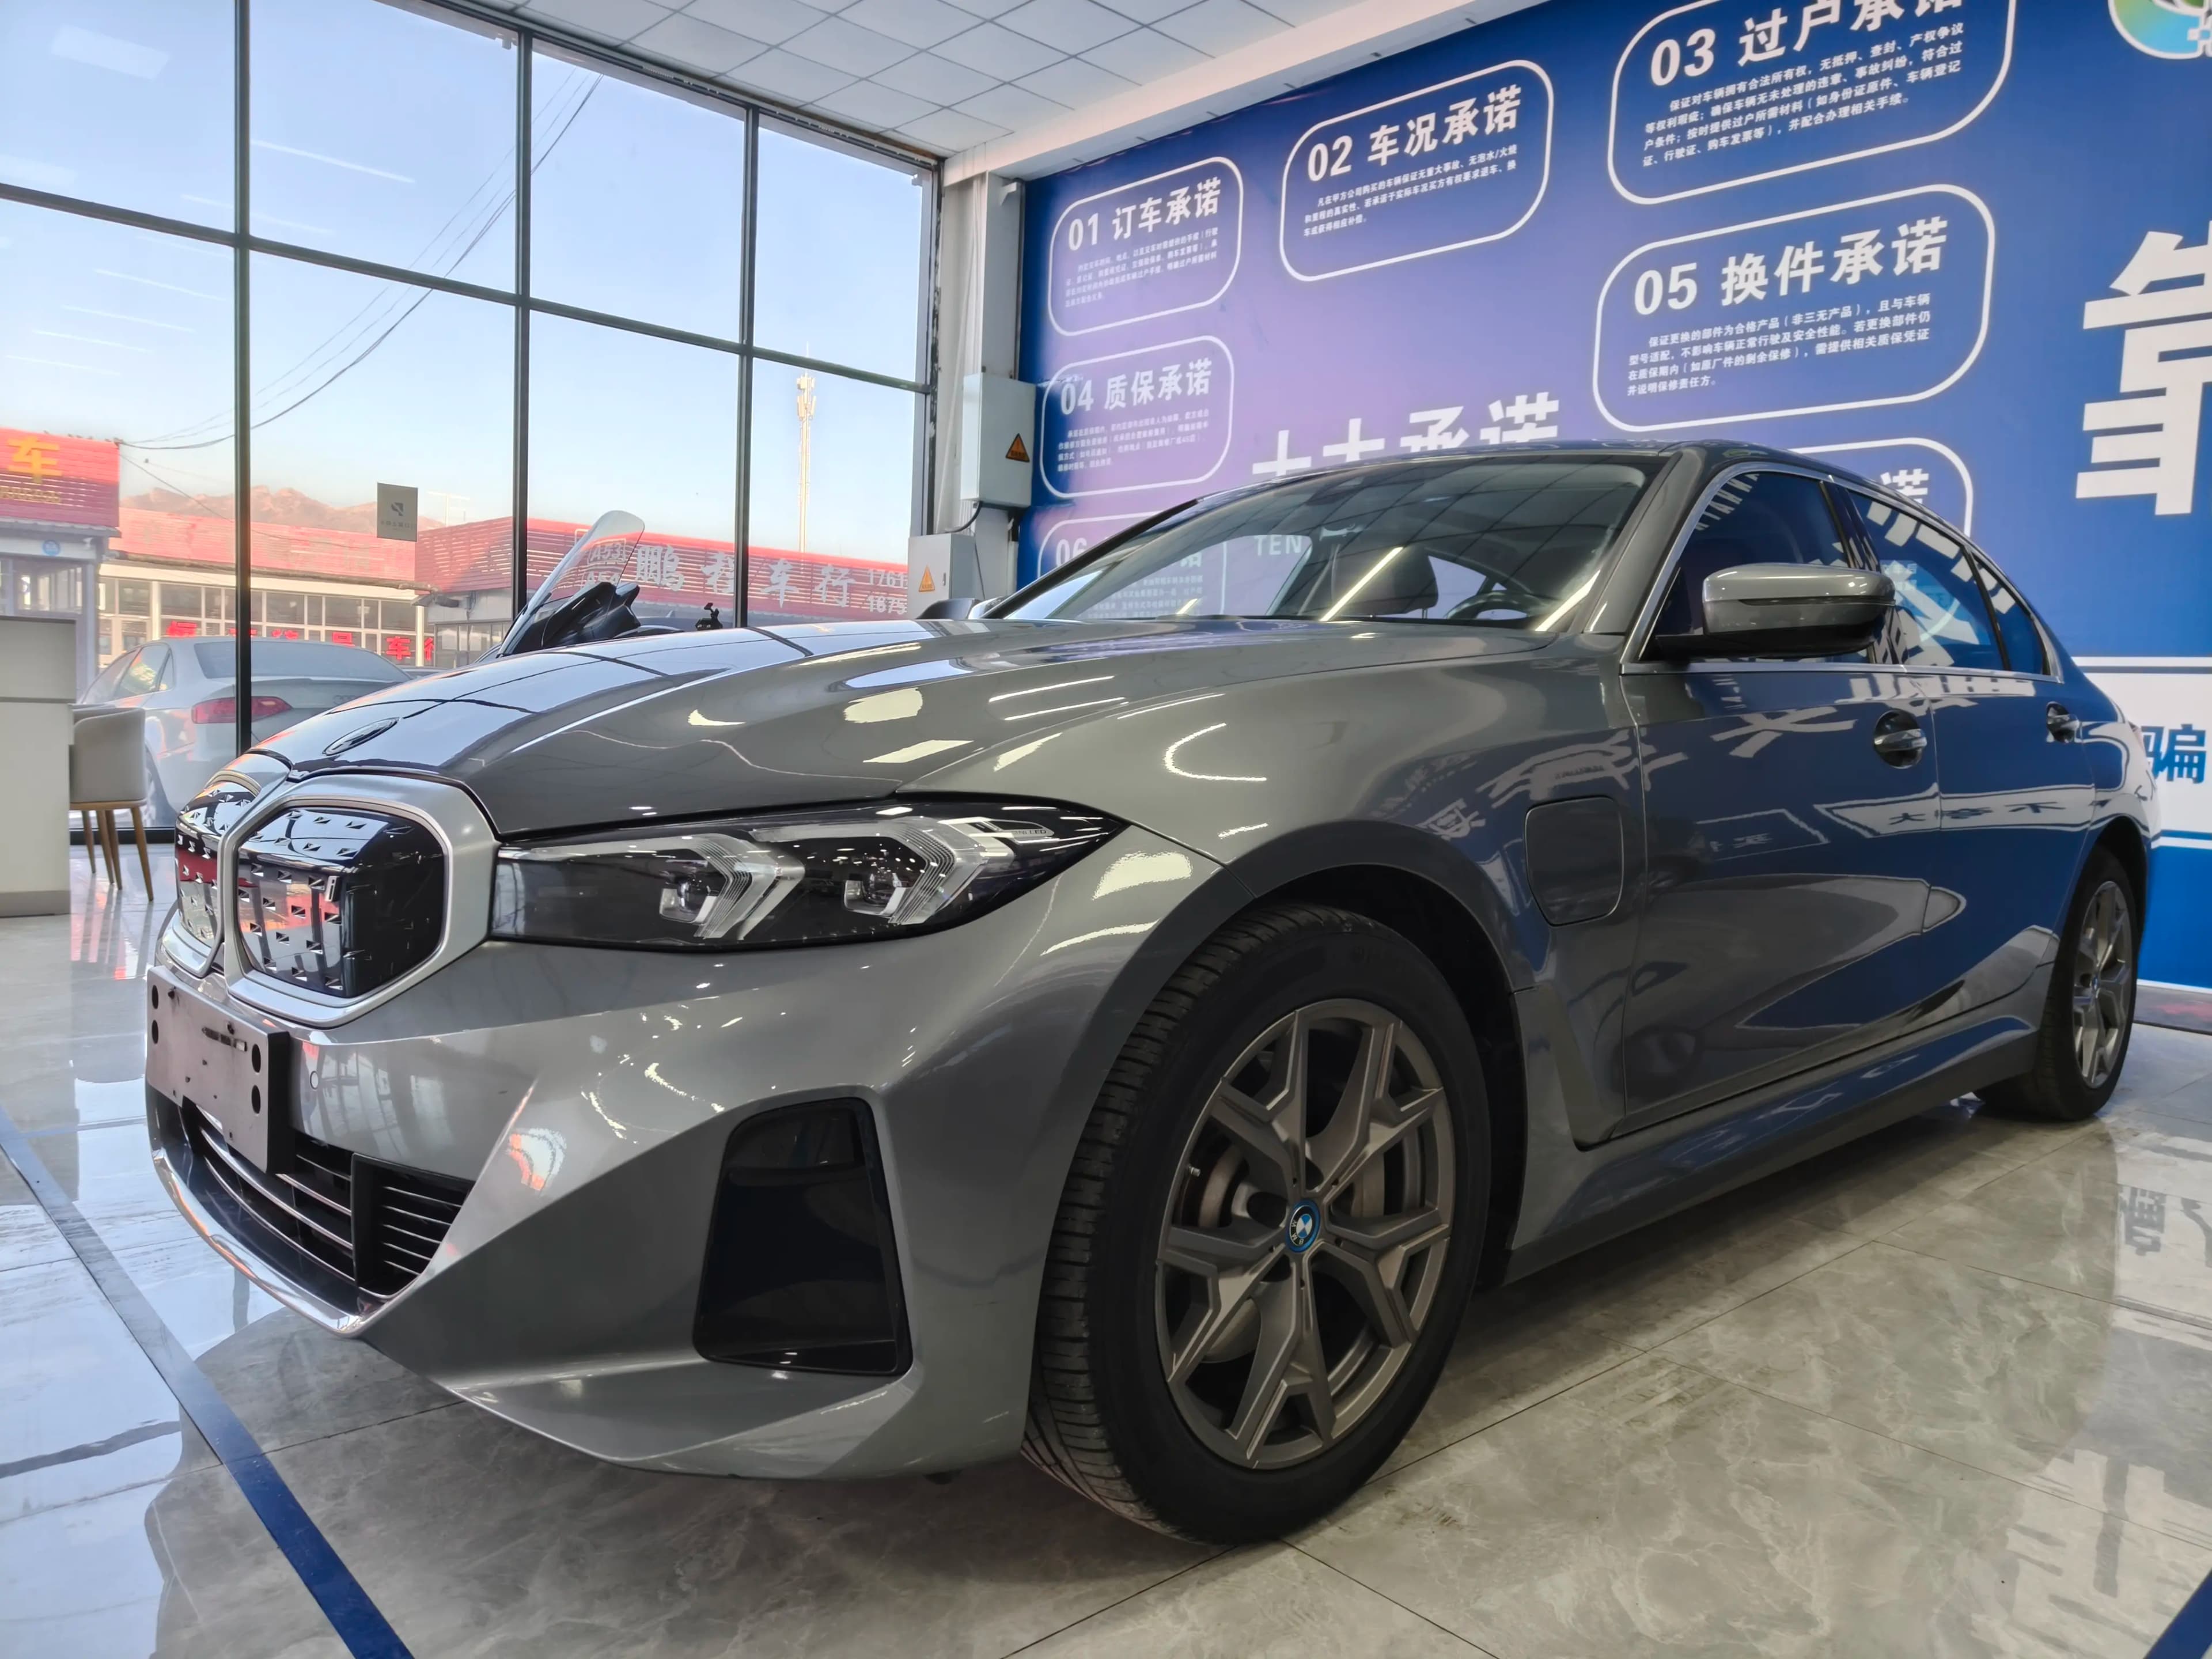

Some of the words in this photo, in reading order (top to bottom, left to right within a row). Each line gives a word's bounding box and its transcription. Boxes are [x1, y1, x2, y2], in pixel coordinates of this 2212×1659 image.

[1650, 29, 1715, 86] 03
[1738, 0, 1963, 66] 过户承
[1308, 135, 1353, 181] 02
[1368, 84, 1521, 166] 车况承诺
[1069, 213, 1099, 251] 01
[1112, 177, 1221, 240] 订车承诺
[1634, 263, 1697, 315] 05
[1721, 216, 1947, 306] 换件承诺
[1061, 380, 1094, 415] 04
[1104, 358, 1212, 410] 质保承诺
[7, 436, 62, 484] 车
[866, 569, 908, 588] 1761
